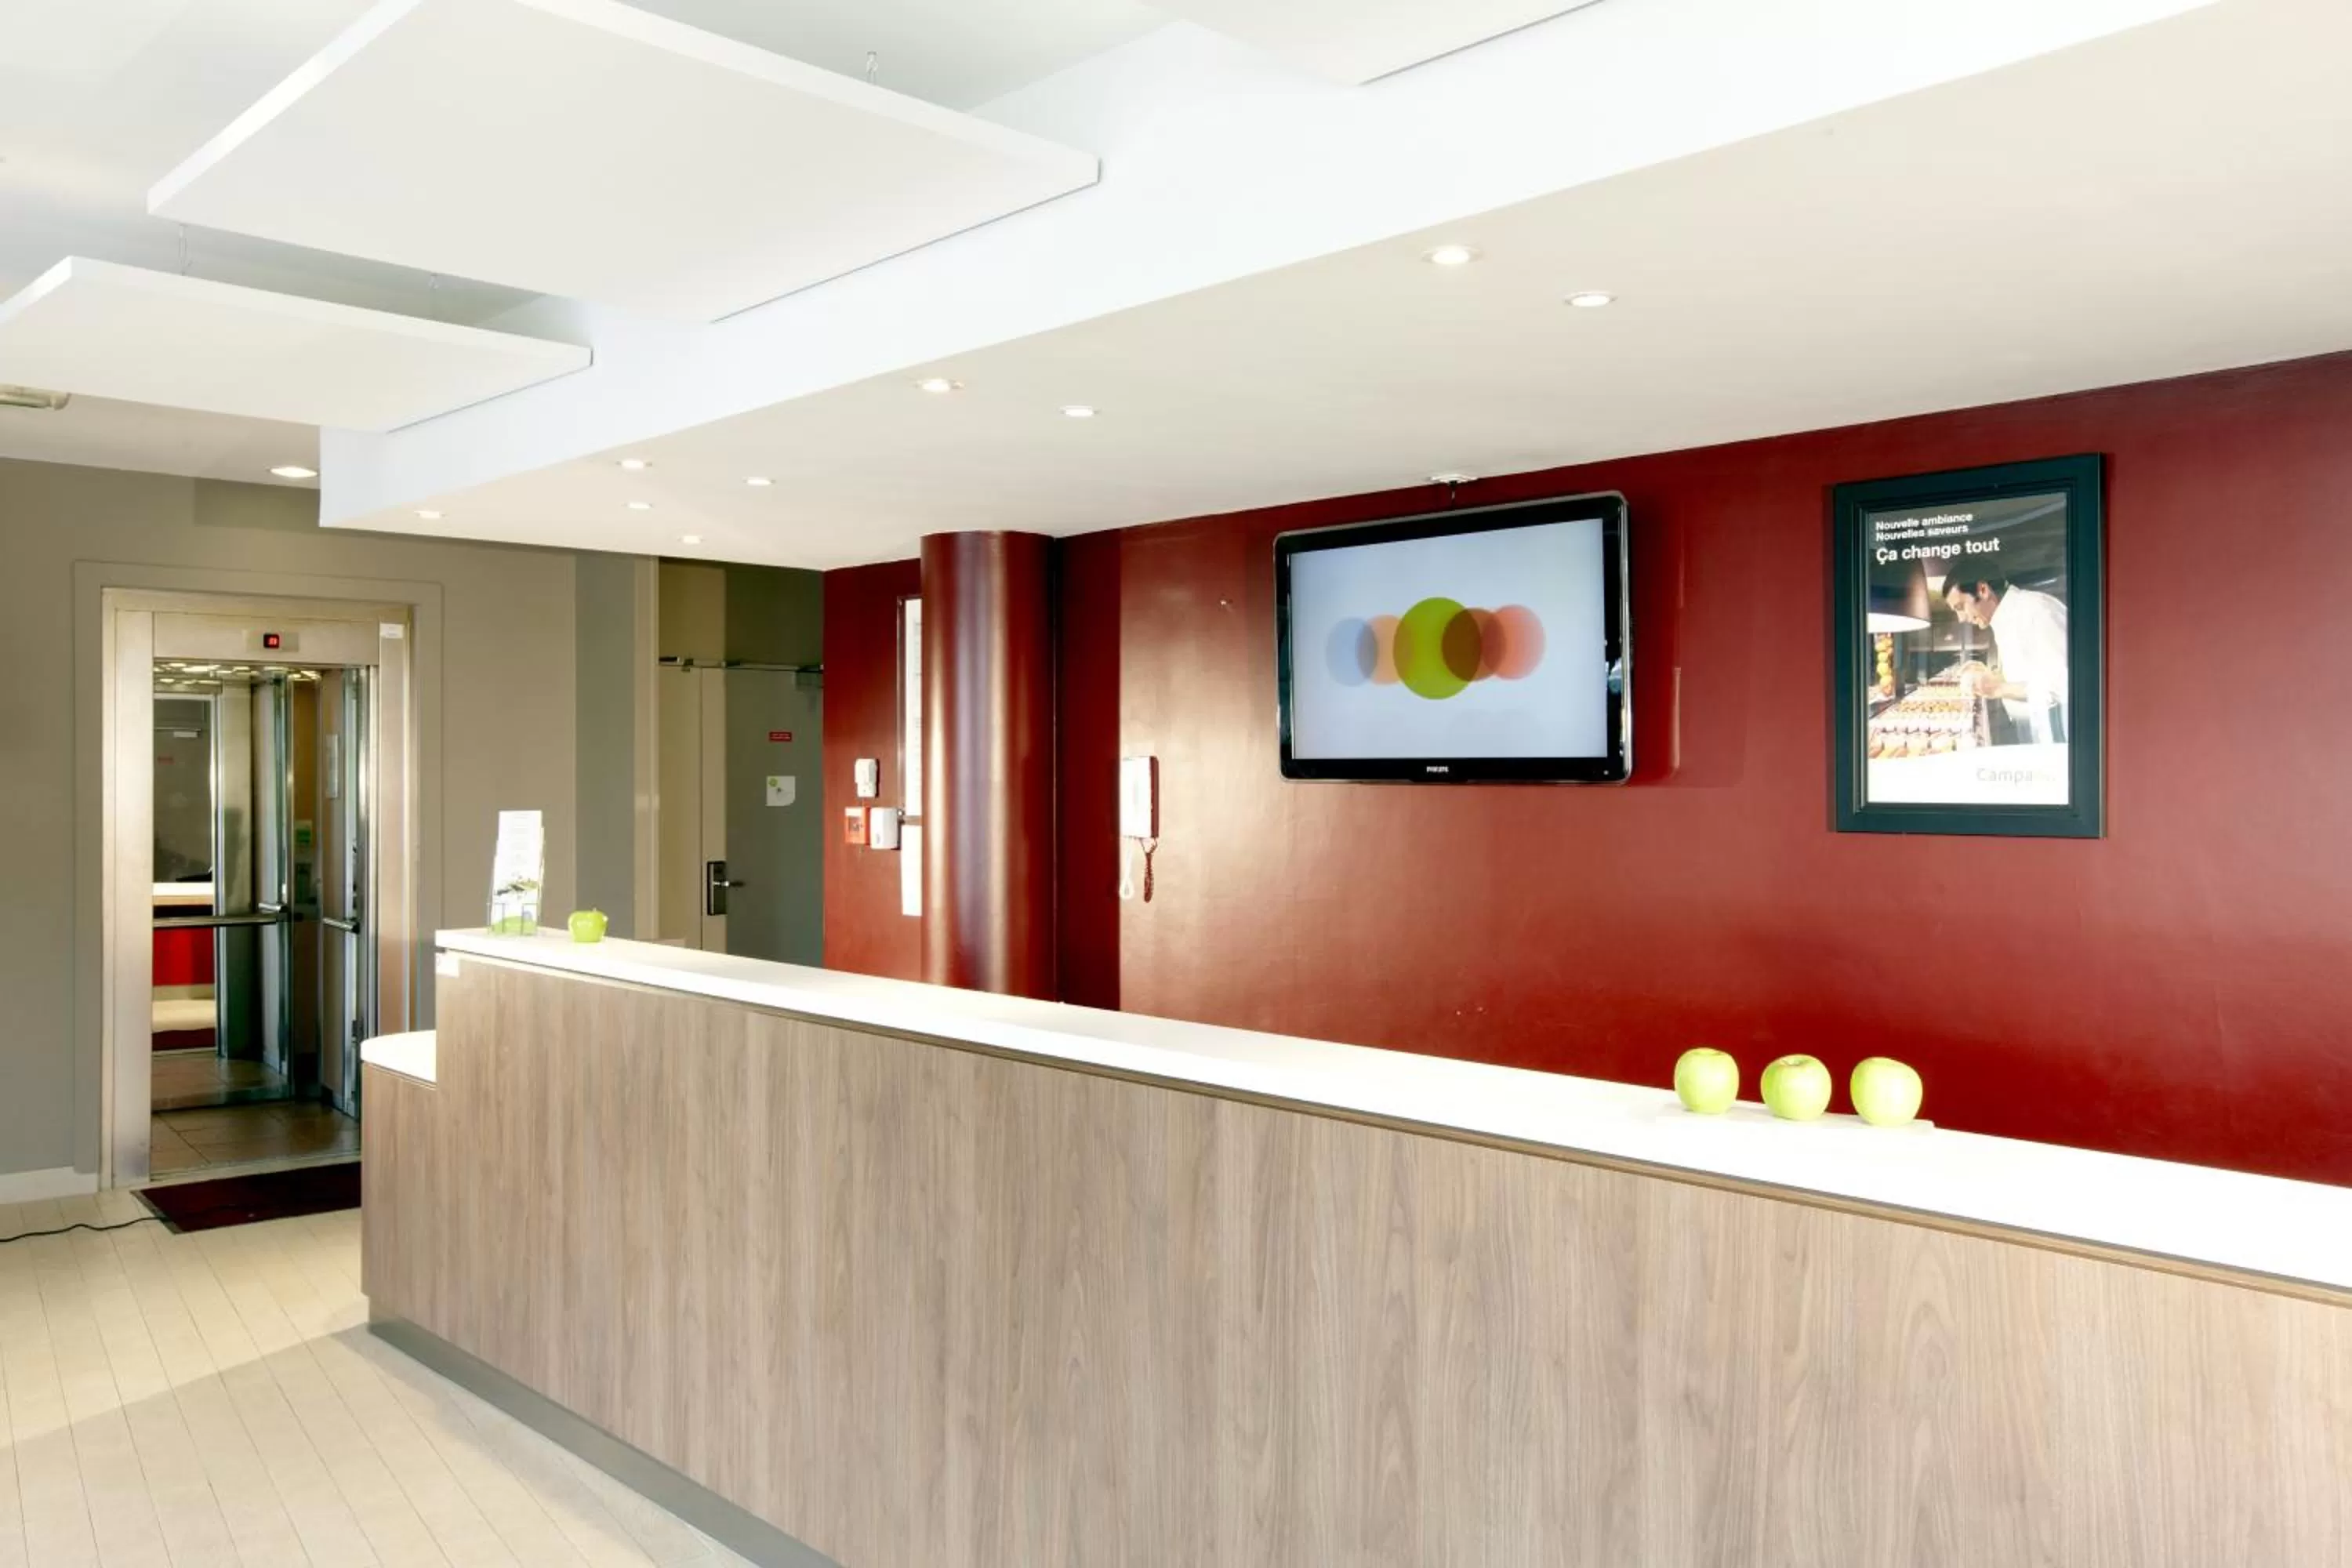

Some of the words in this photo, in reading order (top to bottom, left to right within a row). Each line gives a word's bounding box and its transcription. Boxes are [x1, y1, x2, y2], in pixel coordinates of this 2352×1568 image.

[1875, 517, 1920, 531] Nouvelle
[1922, 514, 1973, 526] ambiance
[1875, 528, 1925, 542] Nouvelles
[1927, 524, 1969, 536] saveurs
[1876, 546, 1898, 565] Ça
[1901, 543, 1961, 559] change
[1965, 536, 2000, 554] tout
[1975, 766, 2056, 788] Campa
